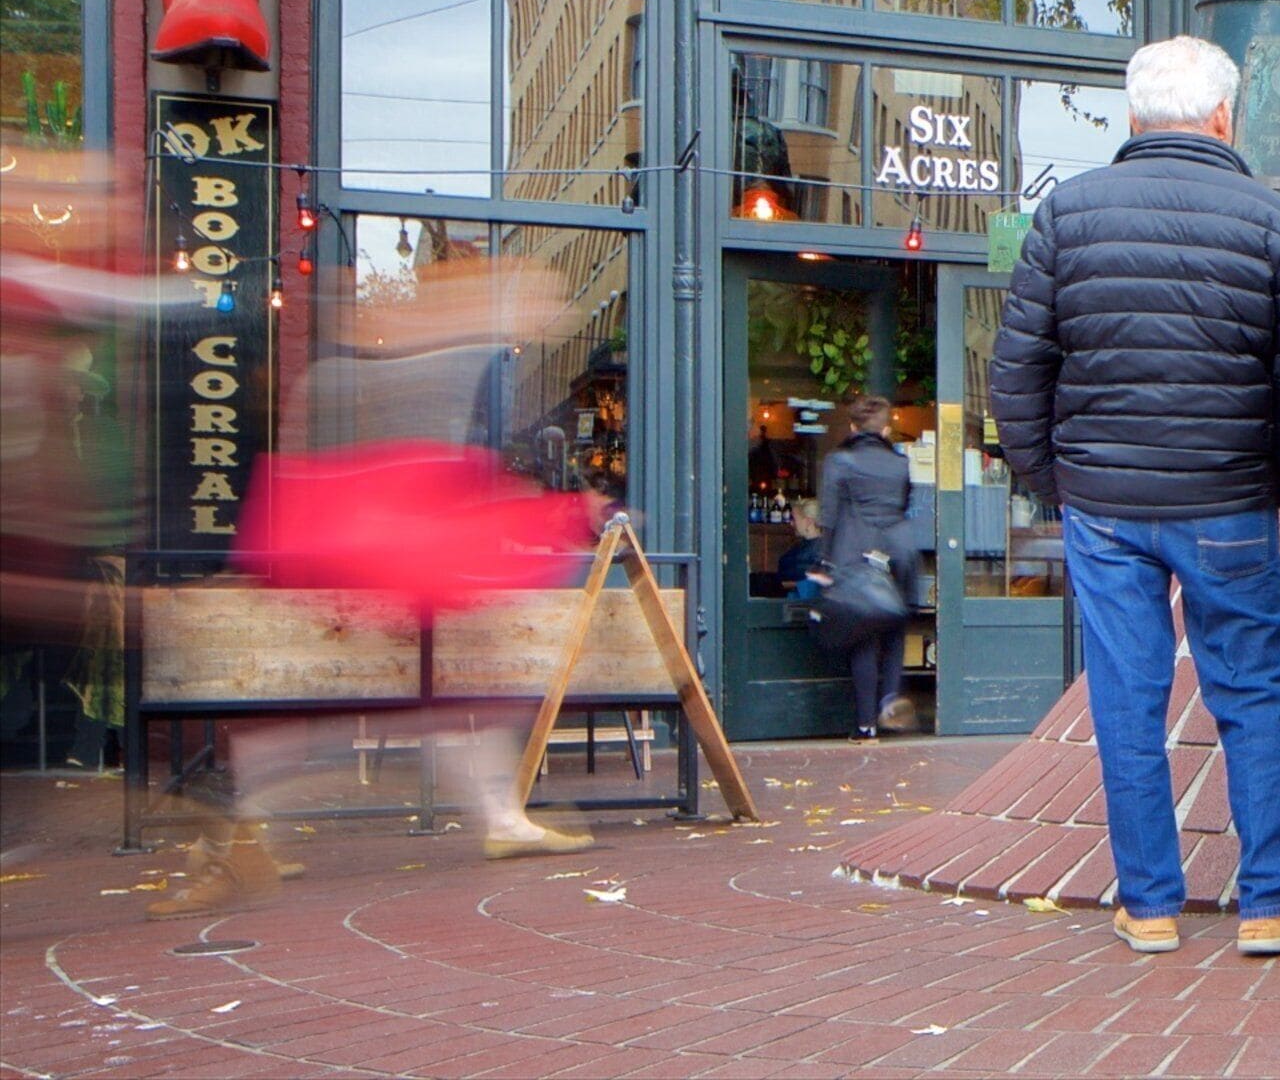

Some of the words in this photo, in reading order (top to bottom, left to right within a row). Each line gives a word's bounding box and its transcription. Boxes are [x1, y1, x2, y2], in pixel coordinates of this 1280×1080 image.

[164, 113, 265, 164] OK
[191, 176, 240, 309] BOOT
[190, 336, 240, 535] CORRAL
